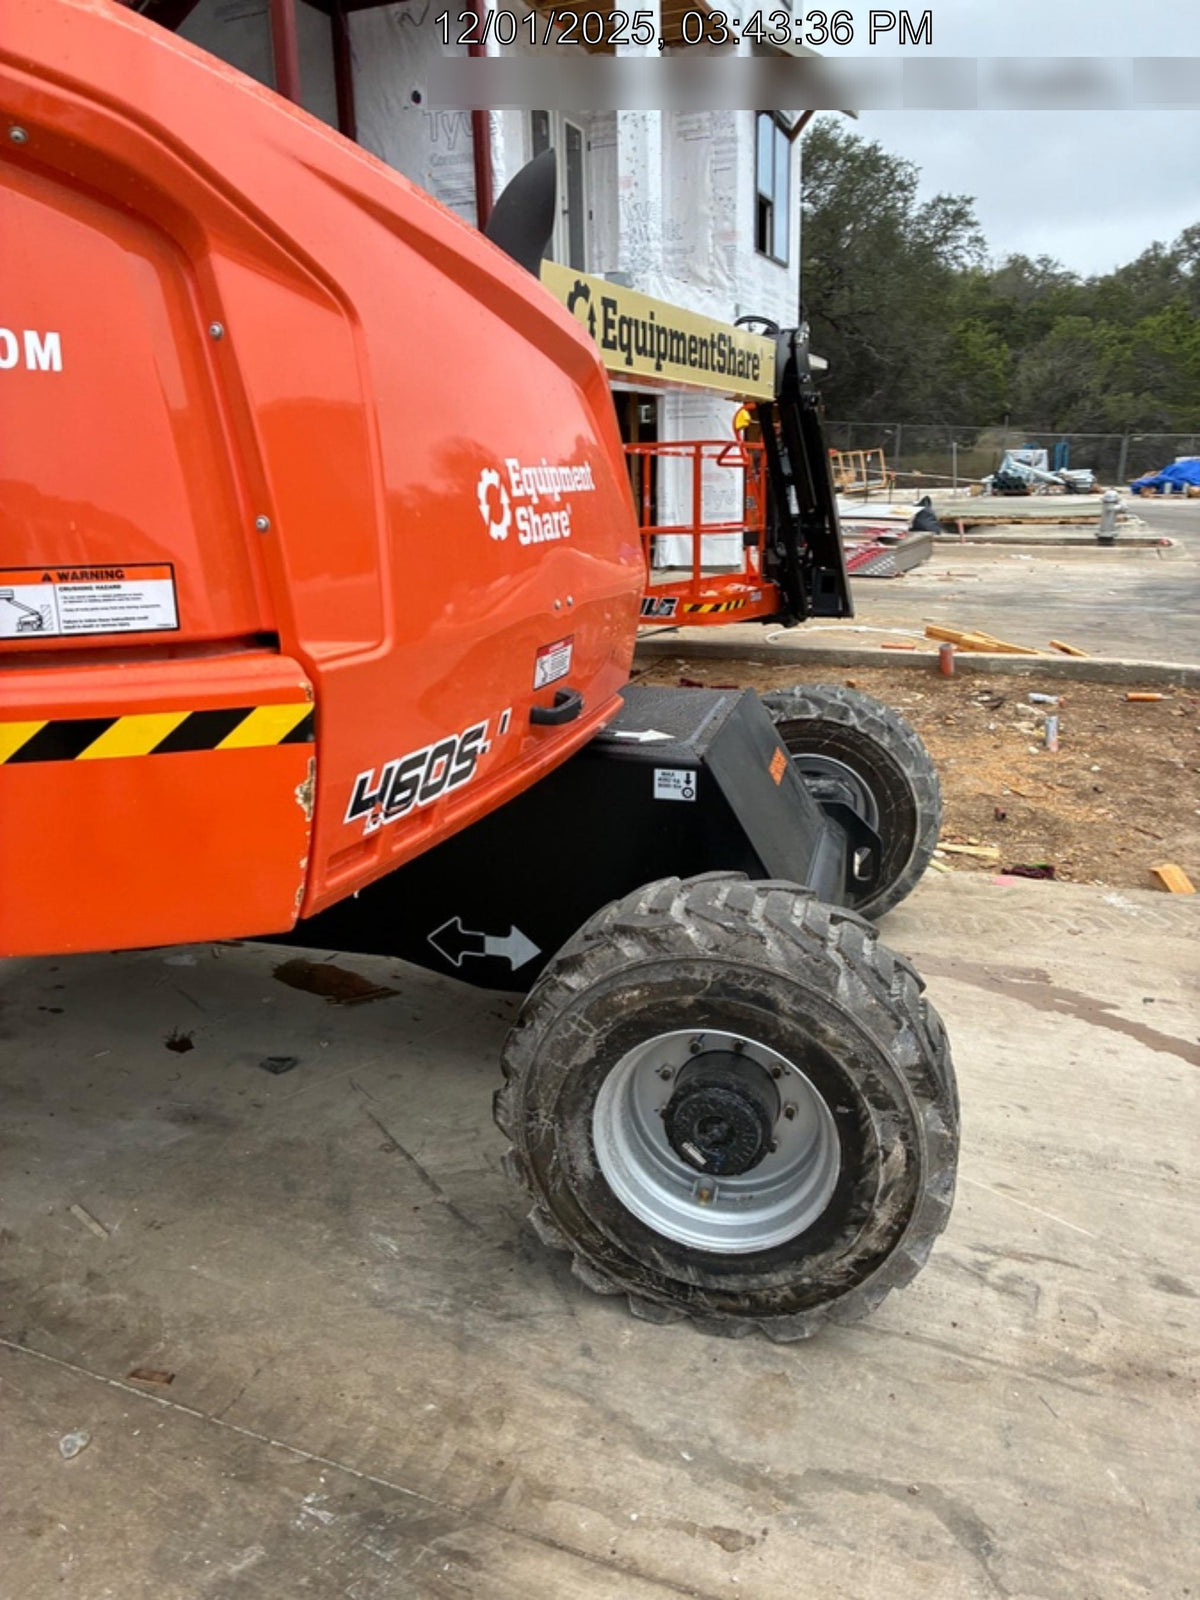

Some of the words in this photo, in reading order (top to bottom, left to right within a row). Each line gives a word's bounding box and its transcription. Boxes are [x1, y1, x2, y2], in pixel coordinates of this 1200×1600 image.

[600, 296, 761, 382] EquipmentShare
[504, 457, 596, 505] Equipment
[515, 504, 572, 546] Share
[56, 569, 125, 581] WARNING
